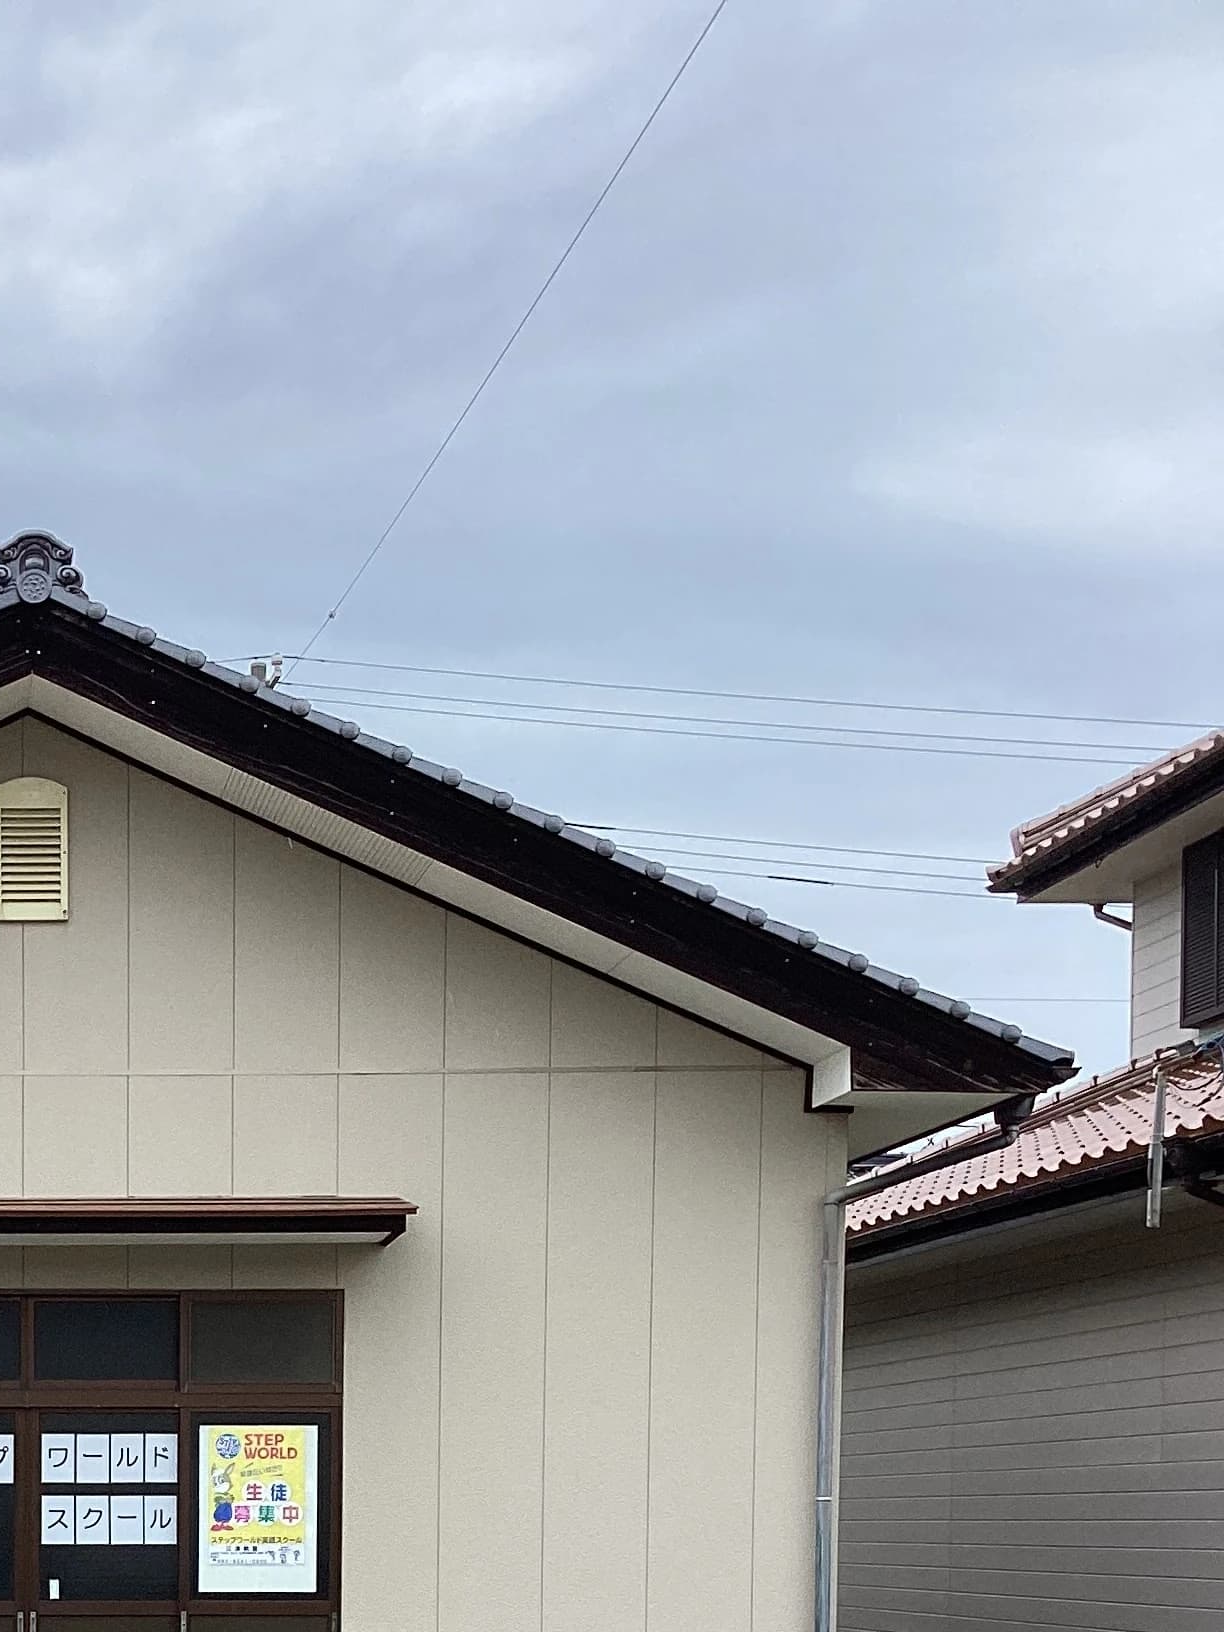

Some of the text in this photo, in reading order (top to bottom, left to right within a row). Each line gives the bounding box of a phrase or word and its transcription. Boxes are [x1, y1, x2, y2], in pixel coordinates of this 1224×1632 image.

[244, 1433, 285, 1446] STEP
[48, 1446, 169, 1468] ワールド
[244, 1447, 298, 1459] WORLD
[246, 1483, 288, 1502] 生徒
[47, 1508, 172, 1530] スクール
[234, 1505, 299, 1524] 募集中
